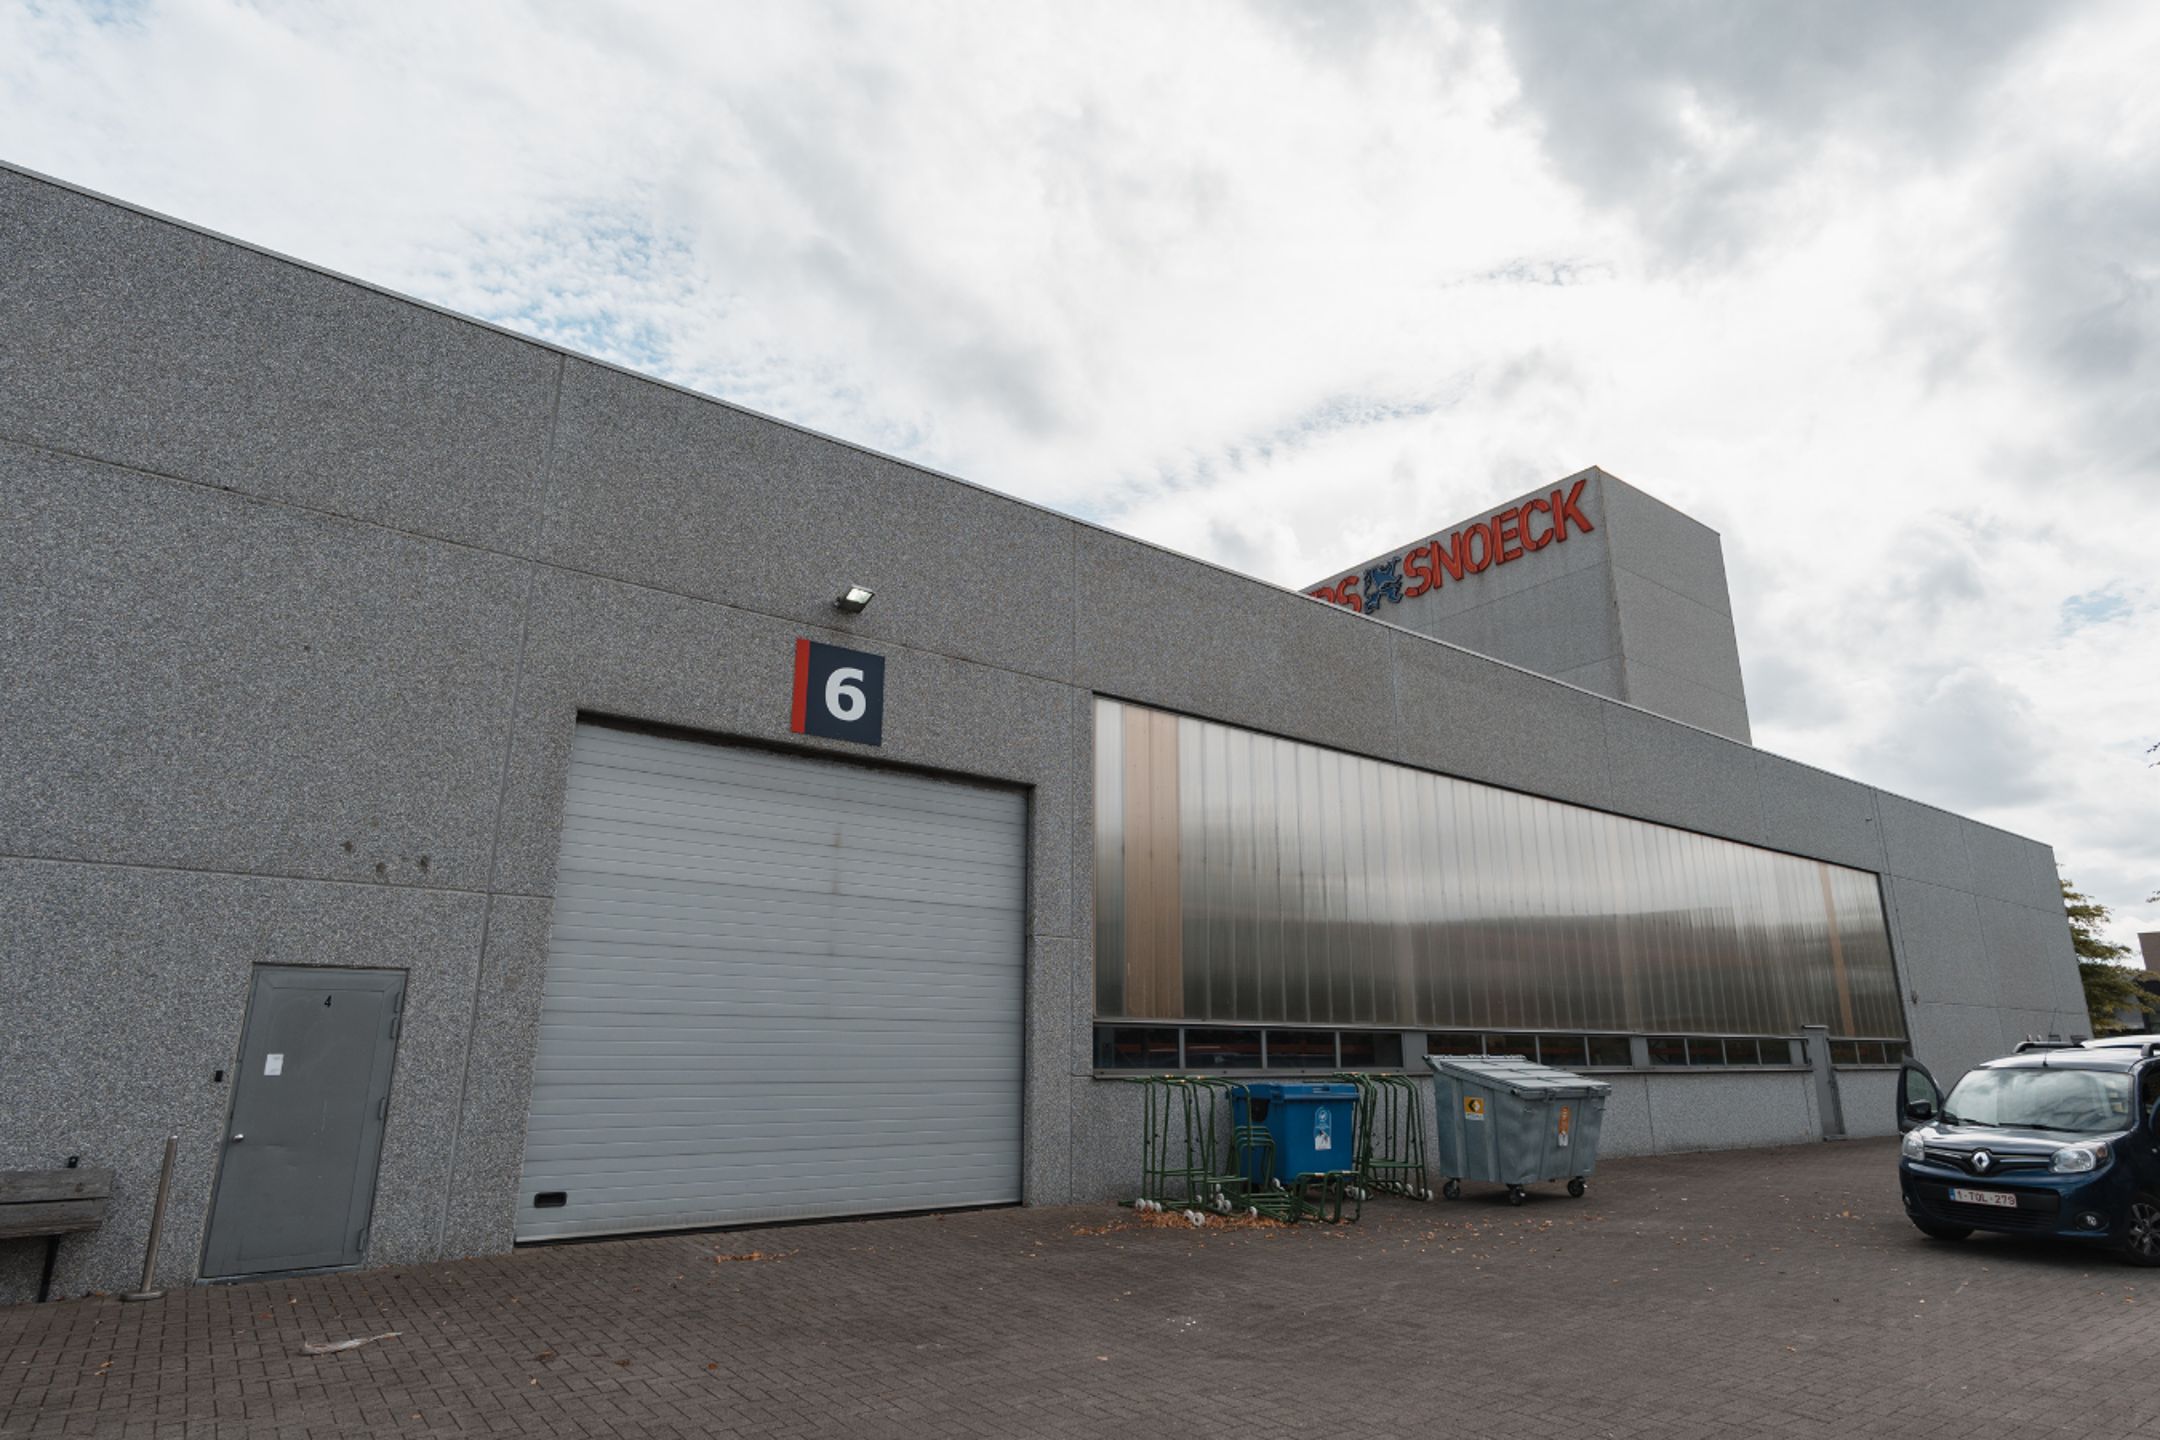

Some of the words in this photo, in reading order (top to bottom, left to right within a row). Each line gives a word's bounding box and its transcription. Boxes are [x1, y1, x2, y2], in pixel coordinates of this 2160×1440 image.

[1403, 478, 1594, 598] SNOECK
[825, 667, 867, 722] 6
[324, 995, 332, 1008] 4
